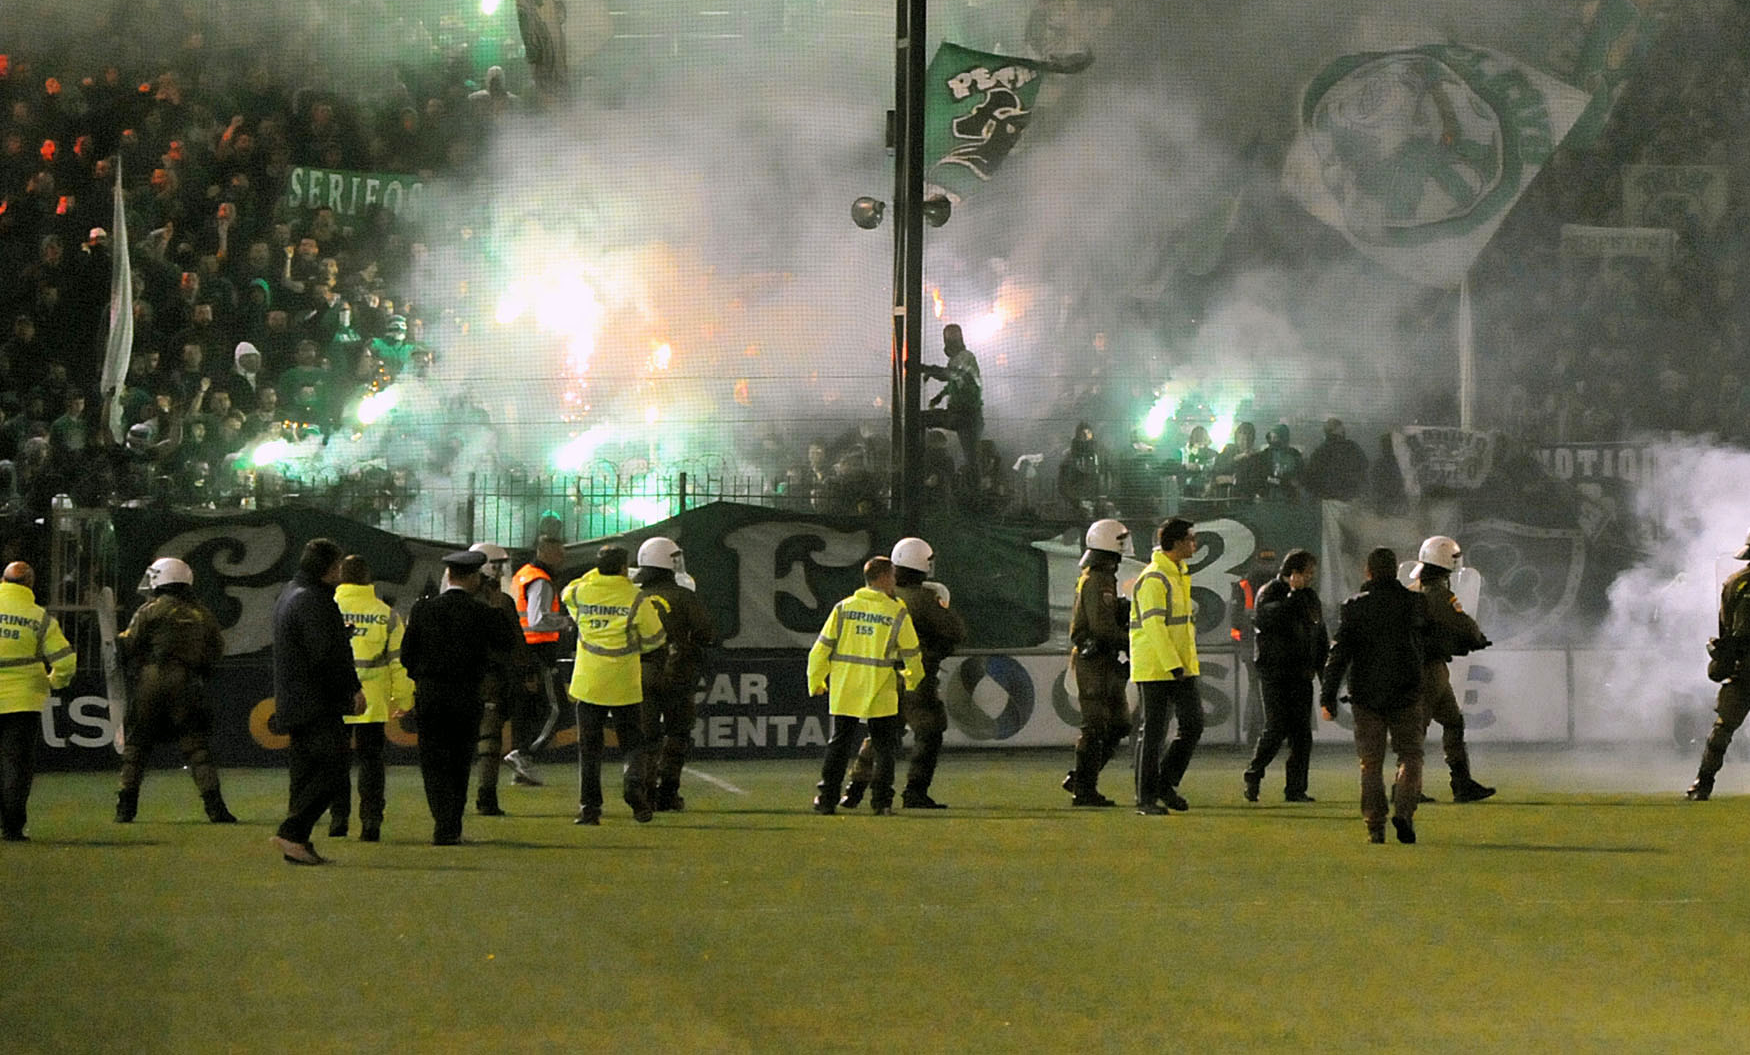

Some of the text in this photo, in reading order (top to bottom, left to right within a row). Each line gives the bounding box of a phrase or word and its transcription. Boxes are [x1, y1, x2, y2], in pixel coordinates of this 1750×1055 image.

[582, 605, 630, 617] BRINKS
[0, 613, 40, 632] RINKS
[342, 613, 388, 625] RINKS
[849, 610, 894, 627] BRINKS
[856, 625, 874, 636] 155
[690, 715, 827, 747] ENTA
